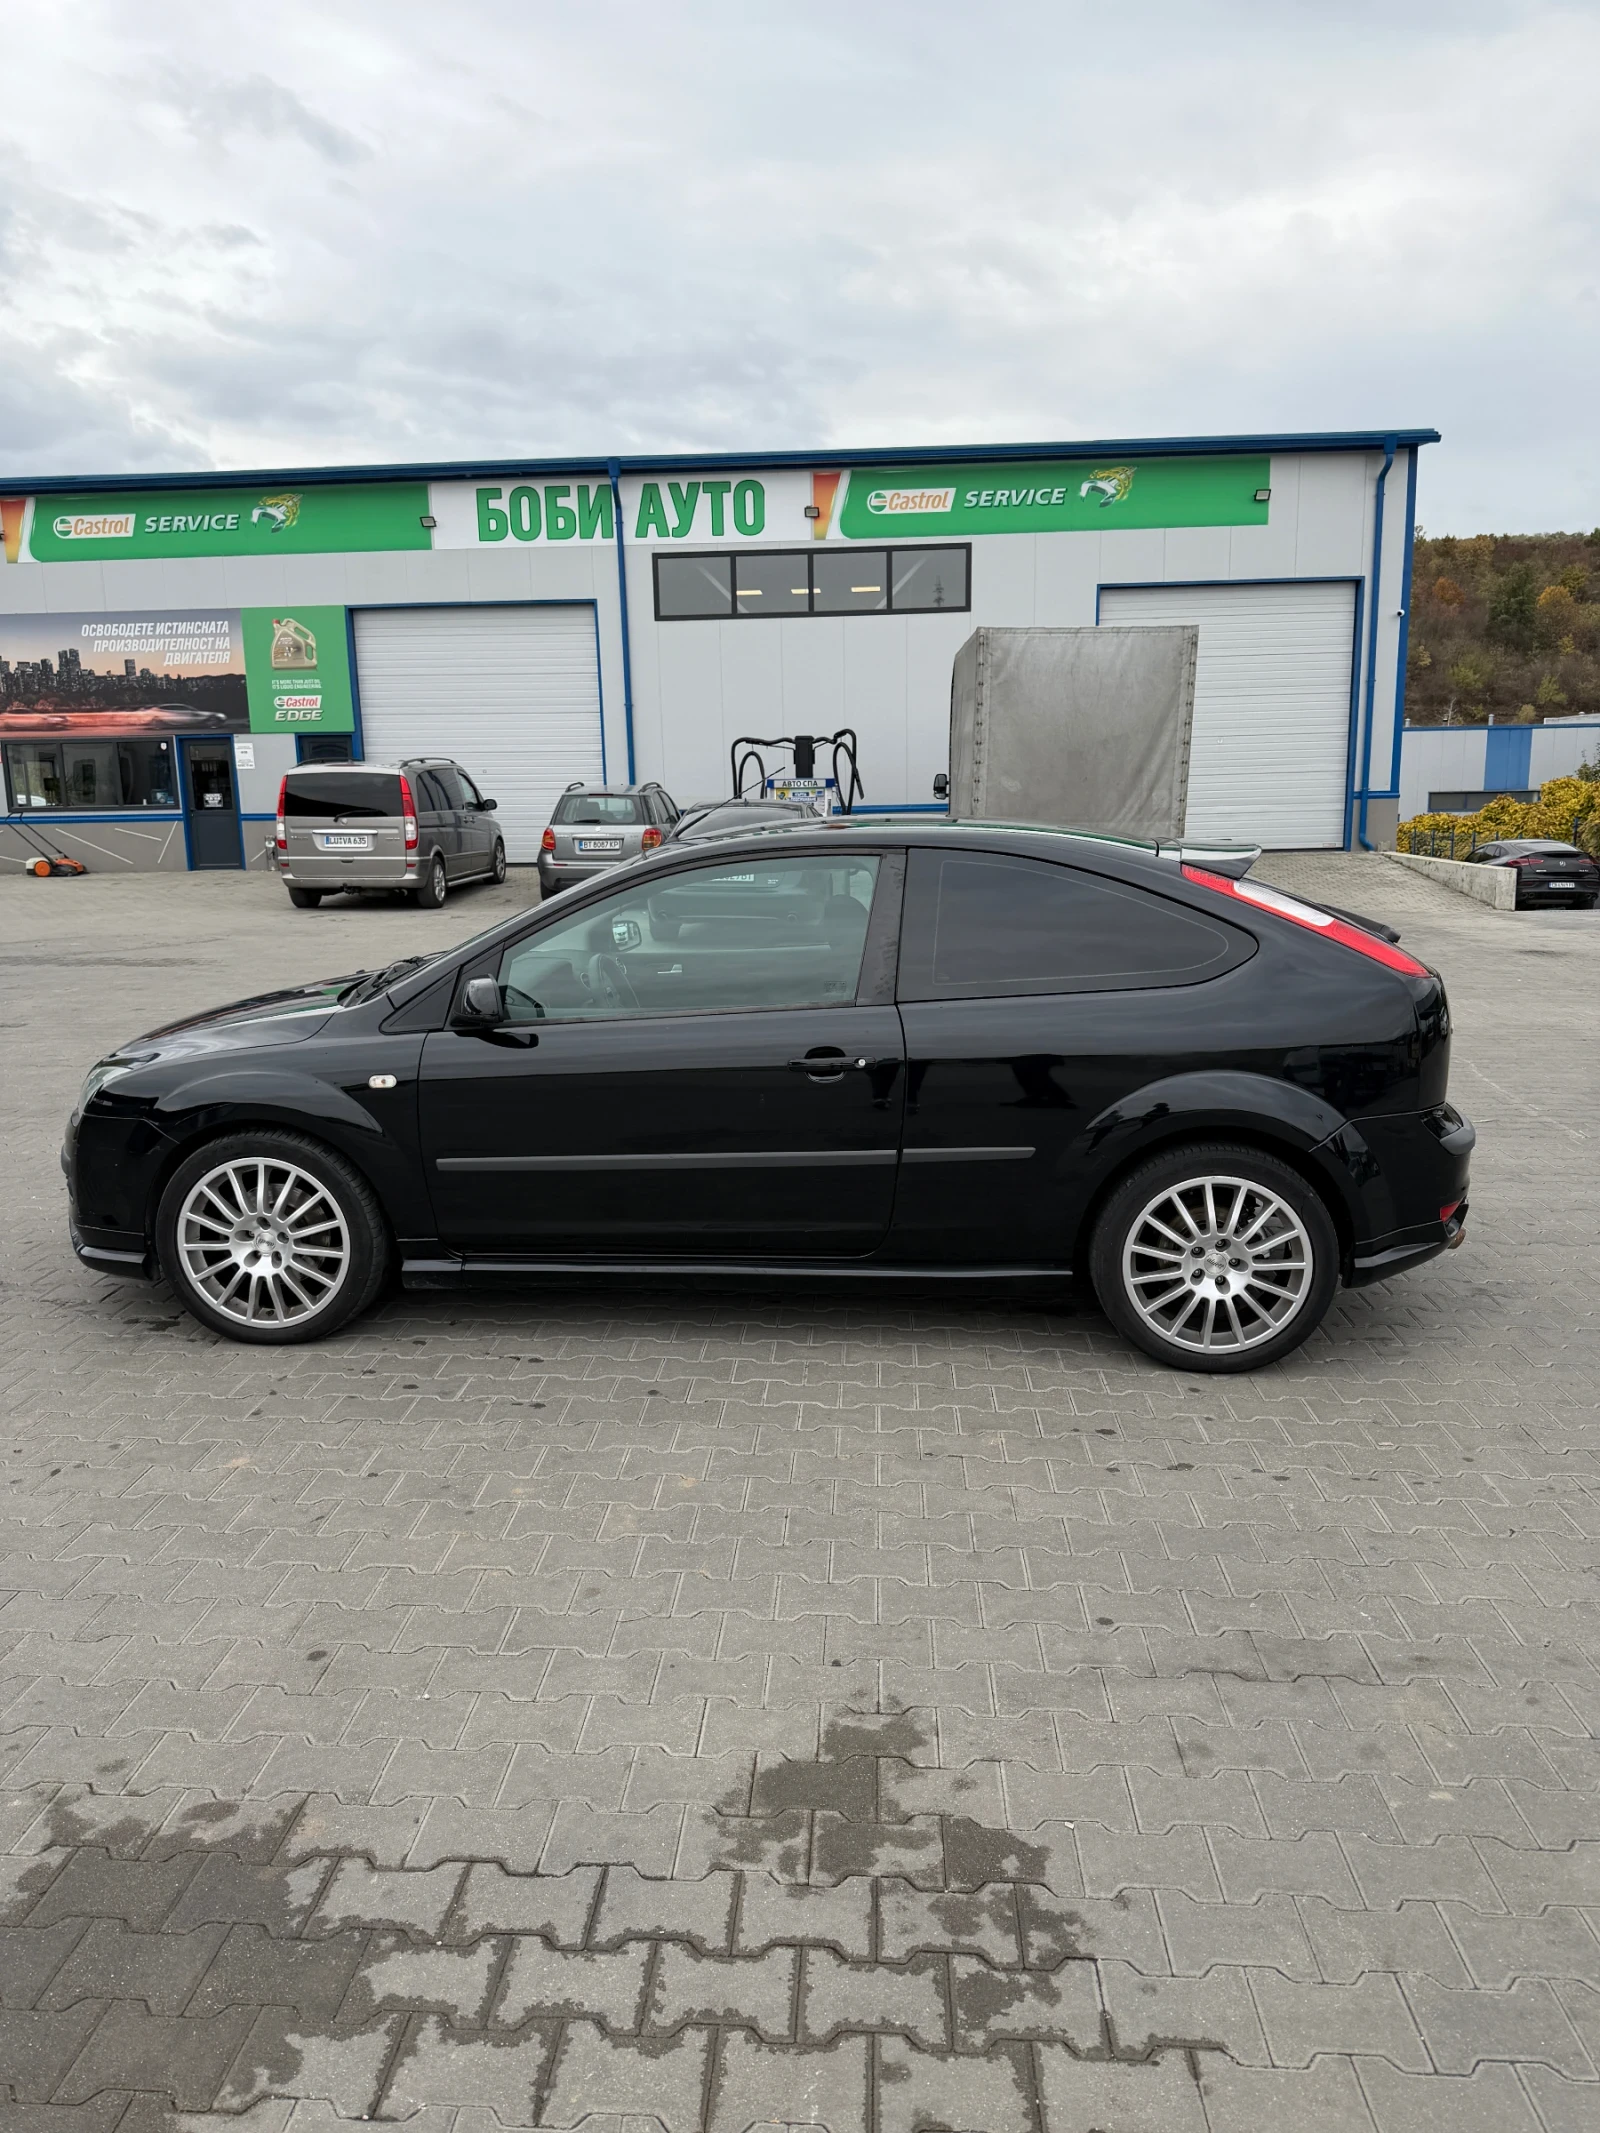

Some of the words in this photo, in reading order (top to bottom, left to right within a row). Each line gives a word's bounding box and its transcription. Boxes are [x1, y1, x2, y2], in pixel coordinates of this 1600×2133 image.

[888, 490, 950, 511] Castrol
[964, 487, 1067, 508] SERVICE
[476, 484, 613, 542] БОБИ
[635, 479, 765, 539] АУТО
[73, 516, 131, 536] Castrol
[144, 514, 240, 533] SERVICE
[81, 623, 154, 637] ОСВОБОДЕТЕ
[155, 621, 229, 635] ИСТИНСКАТА
[93, 637, 214, 652] ПРОИЗВОДИТЕЛНОСТ
[215, 637, 230, 650] НА
[164, 651, 231, 666] ДВИГАТЕЛЯ
[286, 697, 319, 707] Castrol
[275, 710, 324, 722] EDGE
[353, 836, 367, 845] 635
